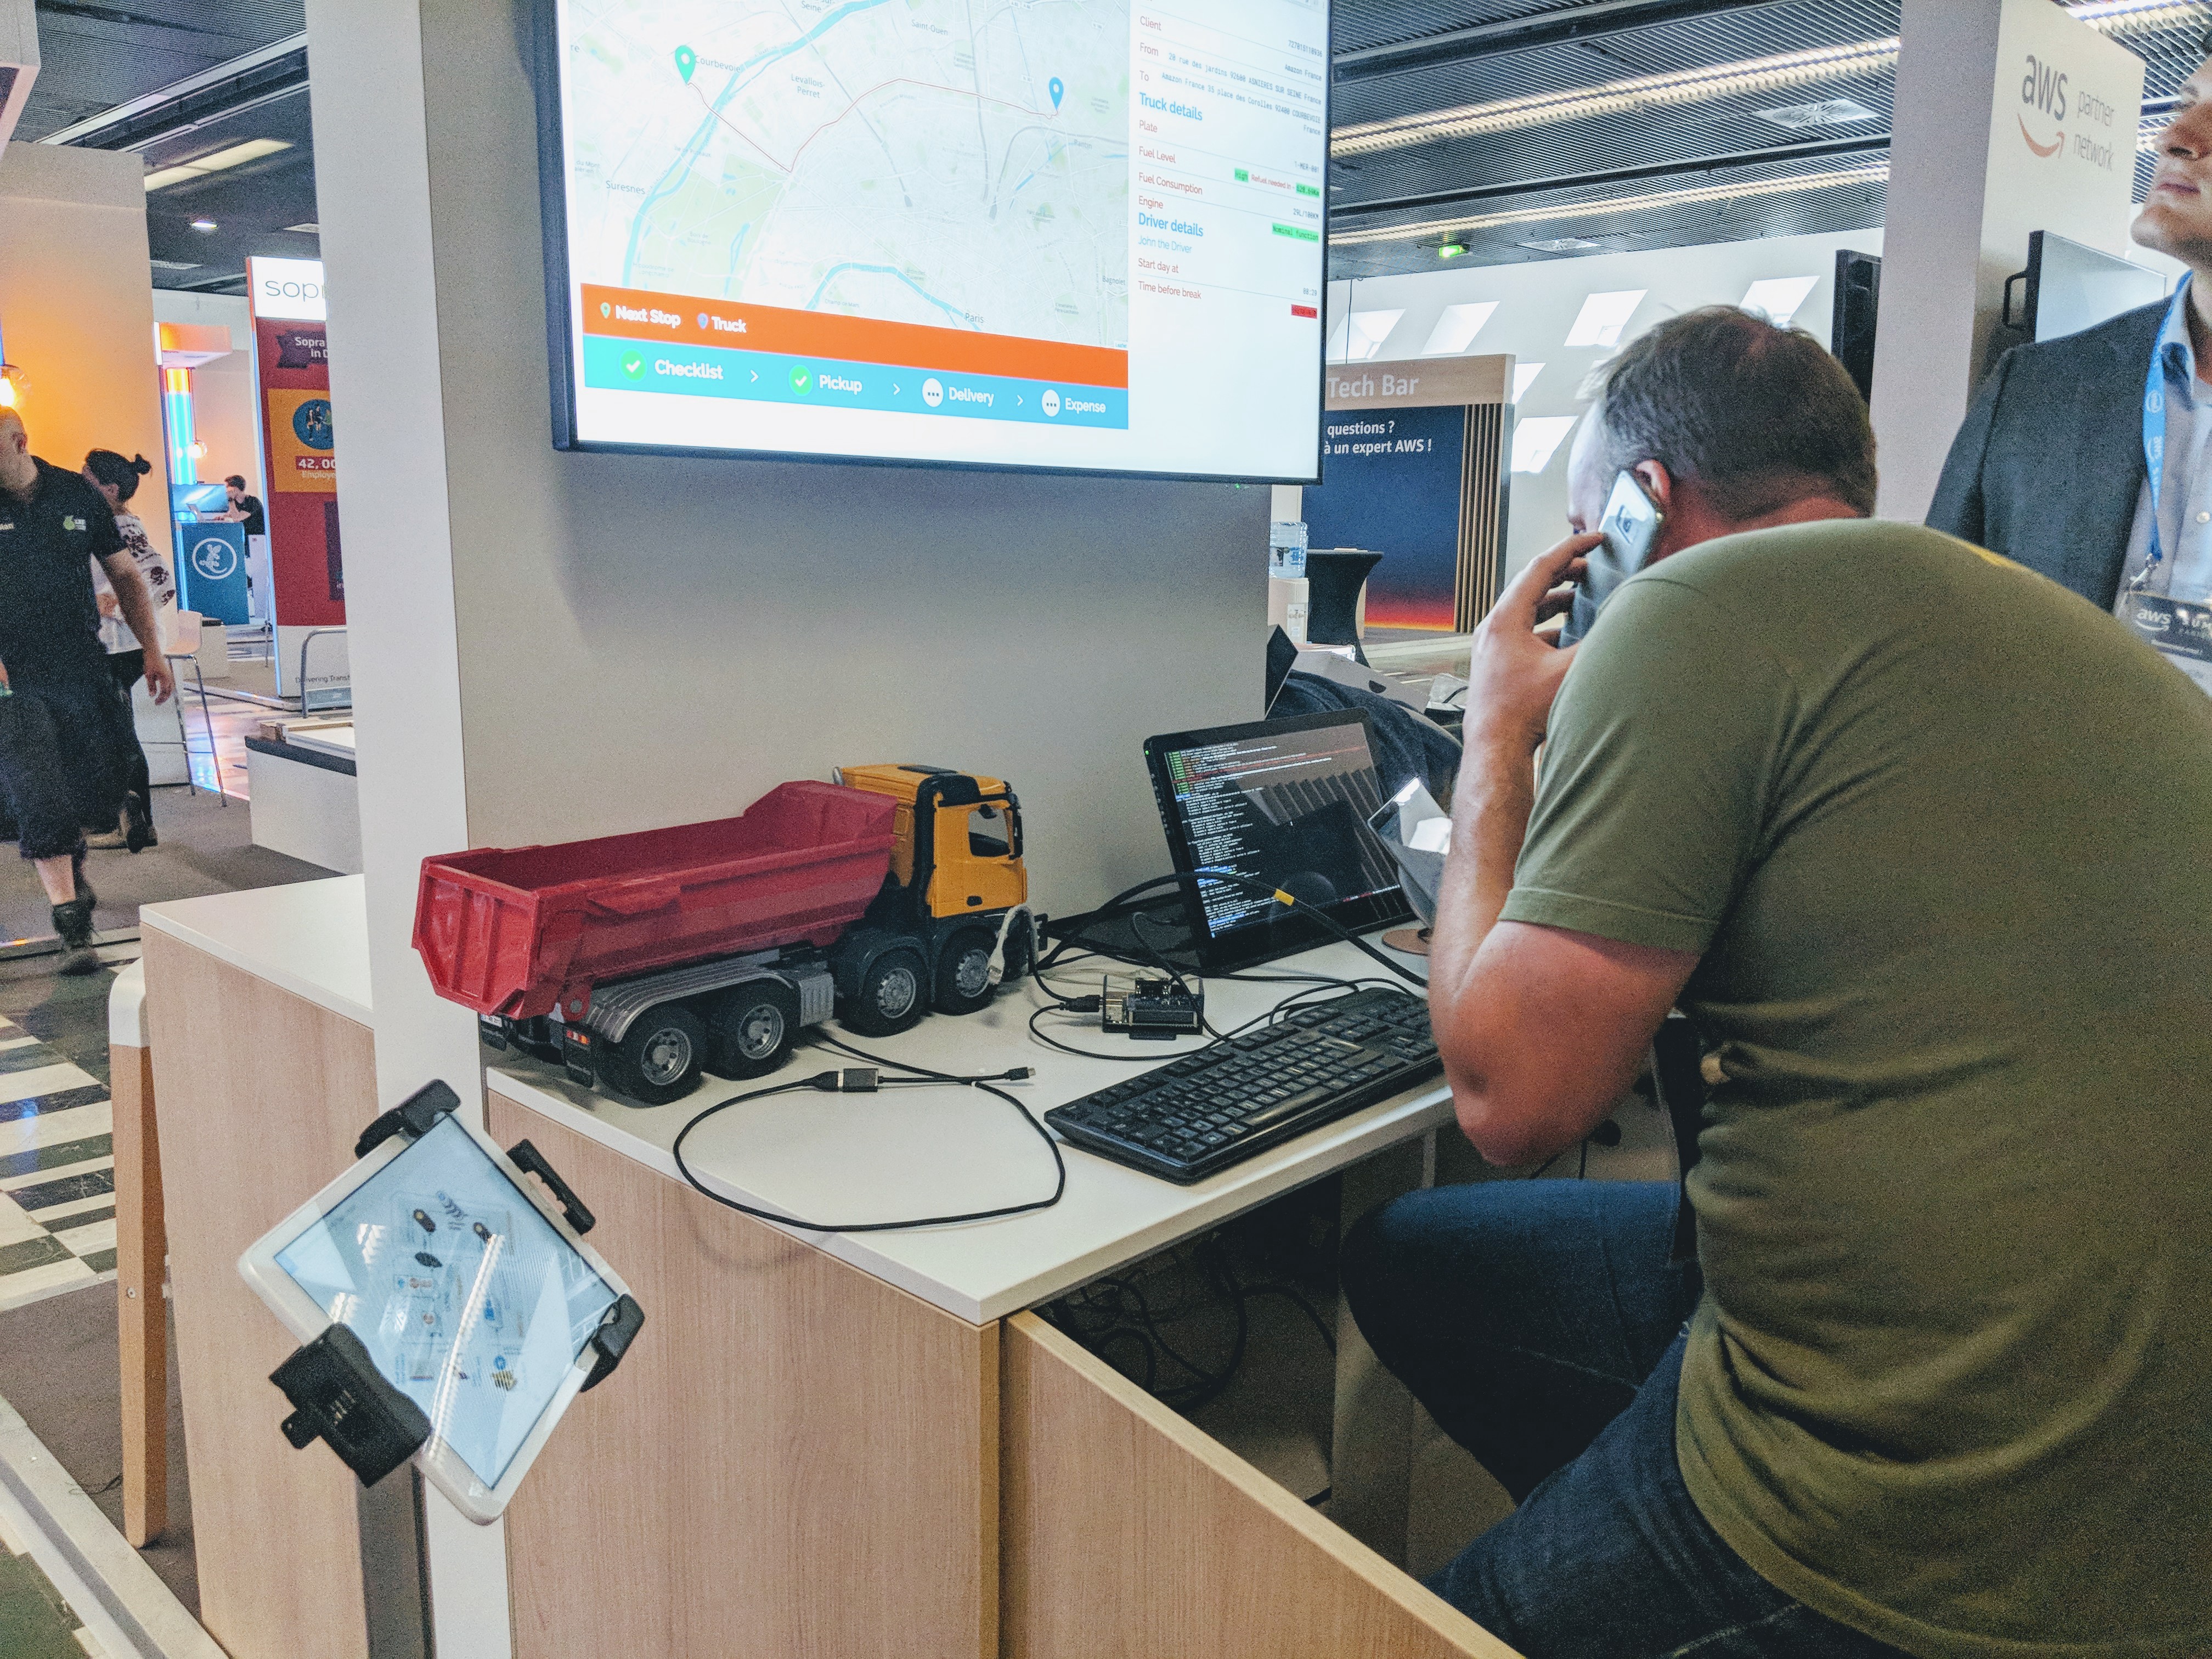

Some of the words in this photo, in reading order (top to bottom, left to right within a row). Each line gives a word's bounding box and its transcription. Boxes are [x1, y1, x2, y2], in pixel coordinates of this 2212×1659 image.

[801, 0, 822, 13] Seine
[911, 19, 949, 36] Saint-Ouen
[1140, 15, 1161, 31] Client
[1140, 42, 1159, 57] From
[695, 55, 741, 74] Courbevoie
[1285, 64, 1302, 75] Amazon
[1305, 70, 1322, 81] France
[791, 74, 825, 88] Levallois-
[1139, 70, 1149, 82] To
[1179, 57, 1189, 65] rue
[1192, 60, 1202, 69] des
[1205, 64, 1228, 77] jardins
[1249, 77, 1273, 91] ASNIERES
[1275, 84, 1284, 94] SUR
[1286, 88, 1302, 99] SEINE
[1304, 93, 1322, 105] France
[797, 87, 821, 99] Perret
[2022, 54, 2068, 121] aws
[1139, 92, 1167, 112] Truck
[1170, 101, 1203, 121] details
[1161, 72, 1182, 84] Amazon
[1185, 78, 1205, 91] France
[1217, 88, 1233, 99] place
[1235, 93, 1245, 102] des
[1248, 96, 1273, 110] Corolles
[1292, 109, 1321, 124] COURBEVOIE
[2077, 91, 2114, 127] partner
[1139, 119, 1158, 133] Plate
[1304, 124, 1321, 136] France
[1074, 139, 1092, 150] Pantin
[2073, 133, 2114, 171] network
[1139, 145, 1155, 159] Fuel
[1156, 150, 1176, 163] Level
[606, 179, 646, 195] Suresnes
[1139, 172, 1155, 184] Fuel
[1156, 176, 1203, 195] Consumption
[1138, 195, 1164, 209] Engine
[1138, 212, 1169, 230] Driver
[1171, 219, 1204, 237] details
[1273, 225, 1293, 236] Nominal
[1296, 229, 1319, 241] function
[1138, 235, 1156, 247] John
[1158, 238, 1170, 250] the
[1171, 240, 1193, 253] Driver
[1138, 257, 1156, 269] Start
[1157, 261, 1170, 274] day
[1172, 264, 1179, 274] at
[1102, 275, 1126, 287] Bagnolet
[1138, 280, 1156, 292] Time
[1158, 283, 1181, 296] before
[1182, 287, 1202, 300] break
[615, 304, 648, 322] Next
[650, 309, 681, 329] Stop
[711, 316, 747, 334] Truck
[965, 312, 985, 325] Paris
[295, 336, 325, 348] Sopra
[311, 348, 321, 358] in
[654, 359, 724, 381] Checklist
[819, 374, 863, 395] Pickup
[949, 387, 994, 408] Delivery
[1065, 398, 1106, 414] Expense
[1327, 374, 1374, 399] Tech
[1381, 374, 1420, 396] Bar
[1327, 421, 1385, 438] questions
[1389, 420, 1395, 433] ?
[1324, 441, 1331, 454] à
[1334, 444, 1350, 454] un
[1352, 442, 1392, 458] expert
[1395, 439, 1425, 453] AWS
[1427, 438, 1432, 452] !
[2137, 608, 2172, 625] aws
